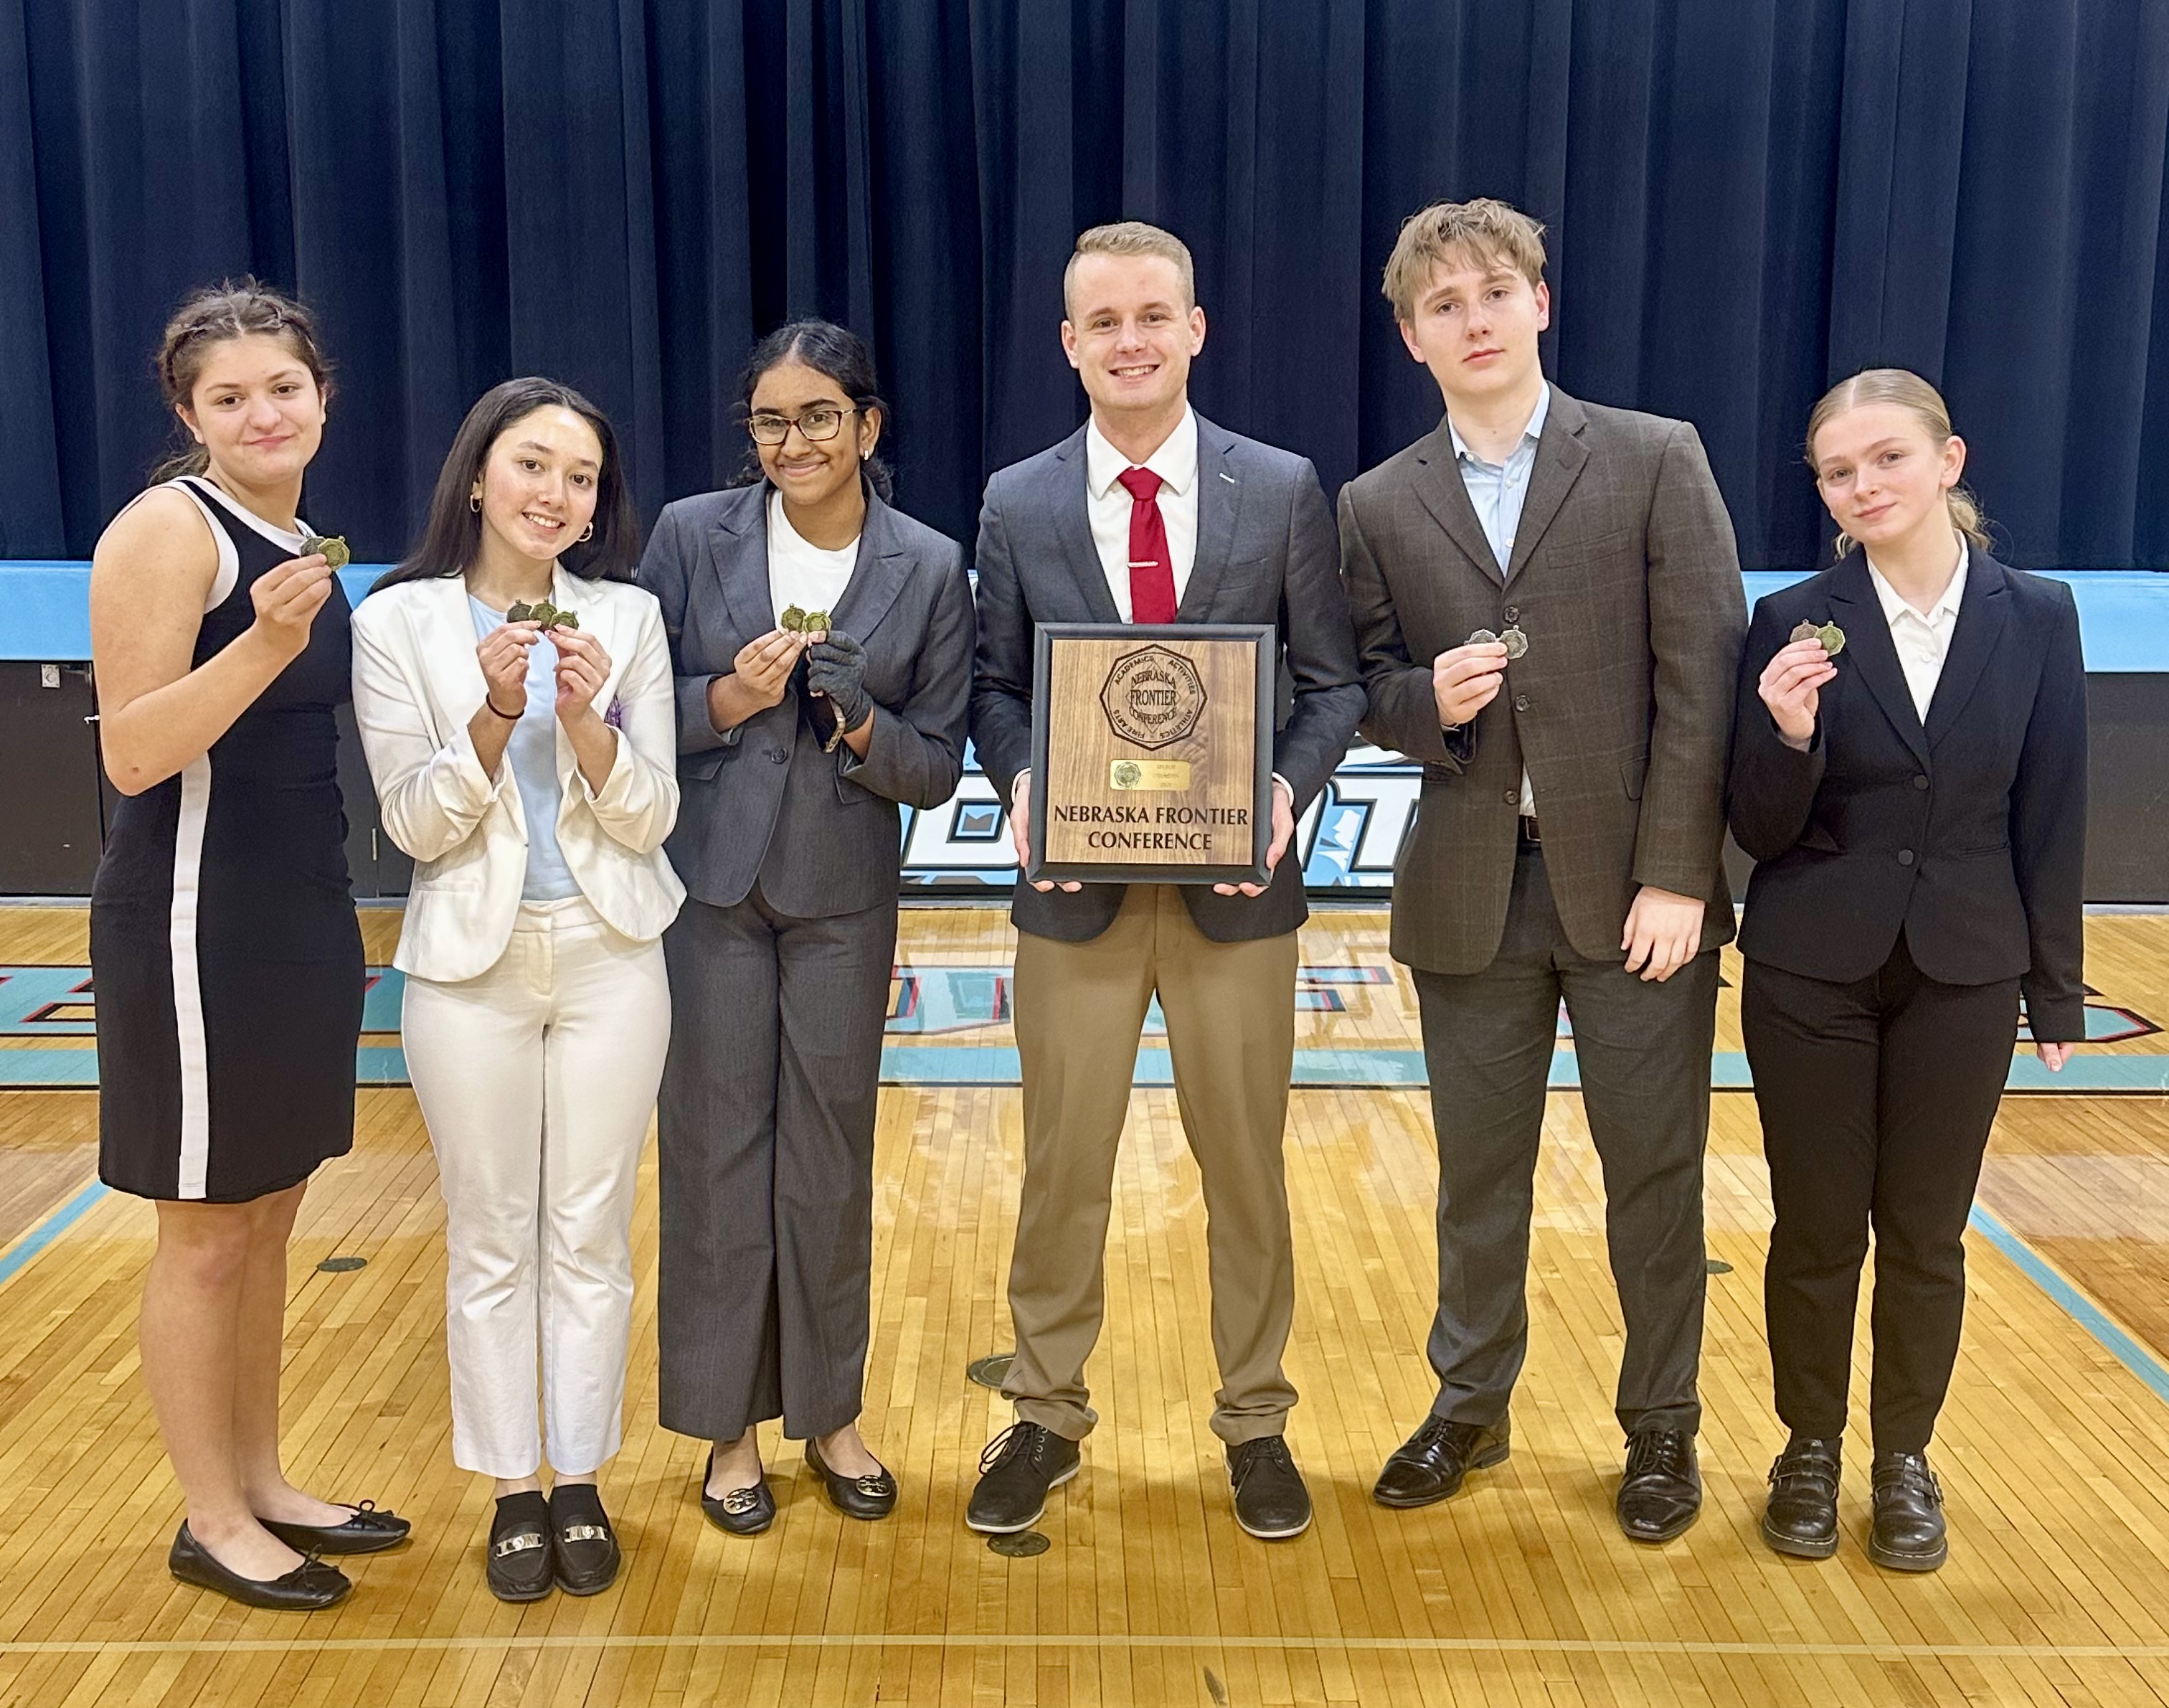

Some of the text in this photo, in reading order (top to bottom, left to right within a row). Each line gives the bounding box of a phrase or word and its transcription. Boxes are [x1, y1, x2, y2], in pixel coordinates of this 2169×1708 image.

[1115, 656, 1154, 685] ACADEMICS
[1131, 670, 1176, 689] NEBRASKA
[1168, 660, 1196, 694] ACTIVITIES
[1130, 689, 1176, 706] FRONTIER
[1113, 709, 1145, 739] FINE ARTS
[1129, 707, 1177, 725] CONFERENCE
[1160, 709, 1193, 739] ATHLETICS
[1054, 805, 1248, 825] NEBRASKA FRONTIER
[1088, 831, 1212, 850] CONFERENCE
